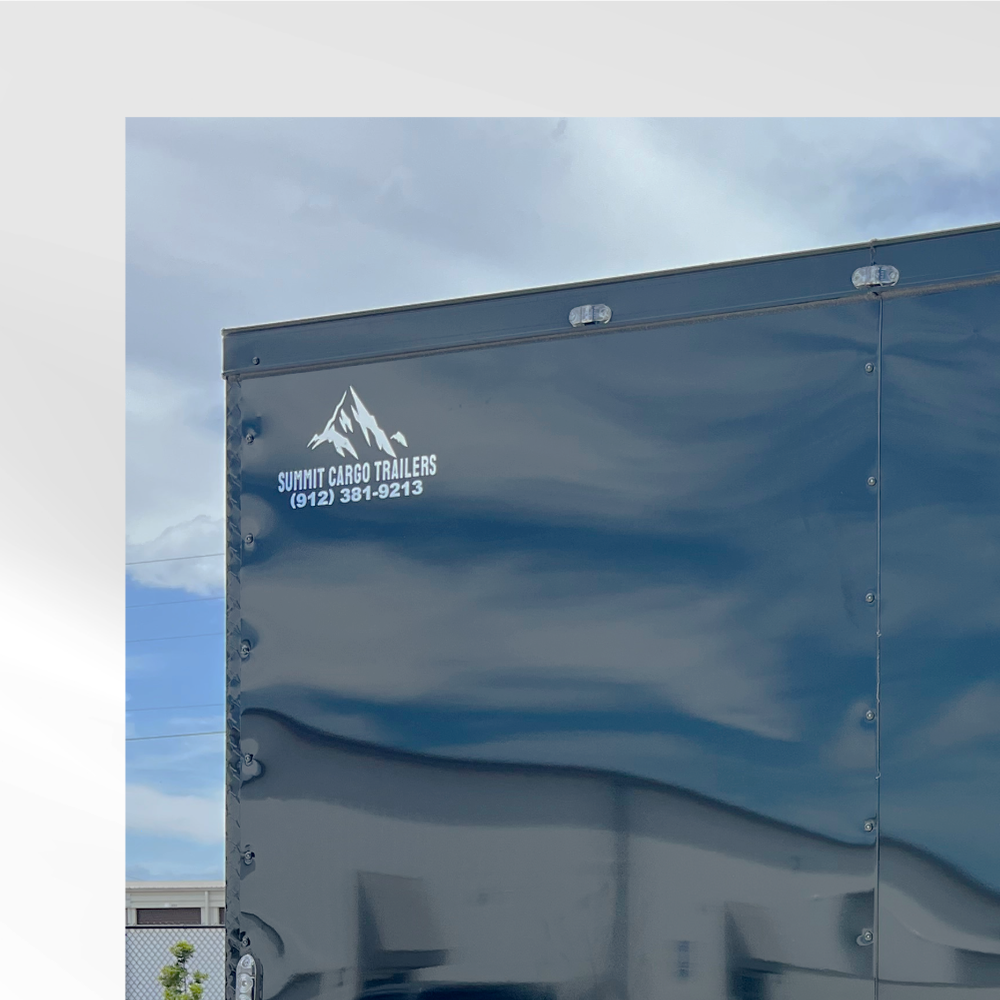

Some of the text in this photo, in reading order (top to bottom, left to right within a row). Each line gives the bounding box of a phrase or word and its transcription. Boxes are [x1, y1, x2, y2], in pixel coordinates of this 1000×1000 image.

[278, 454, 437, 493] SUMMIT CARGO TRAILERS
[290, 480, 423, 509] (912) 381-9213
